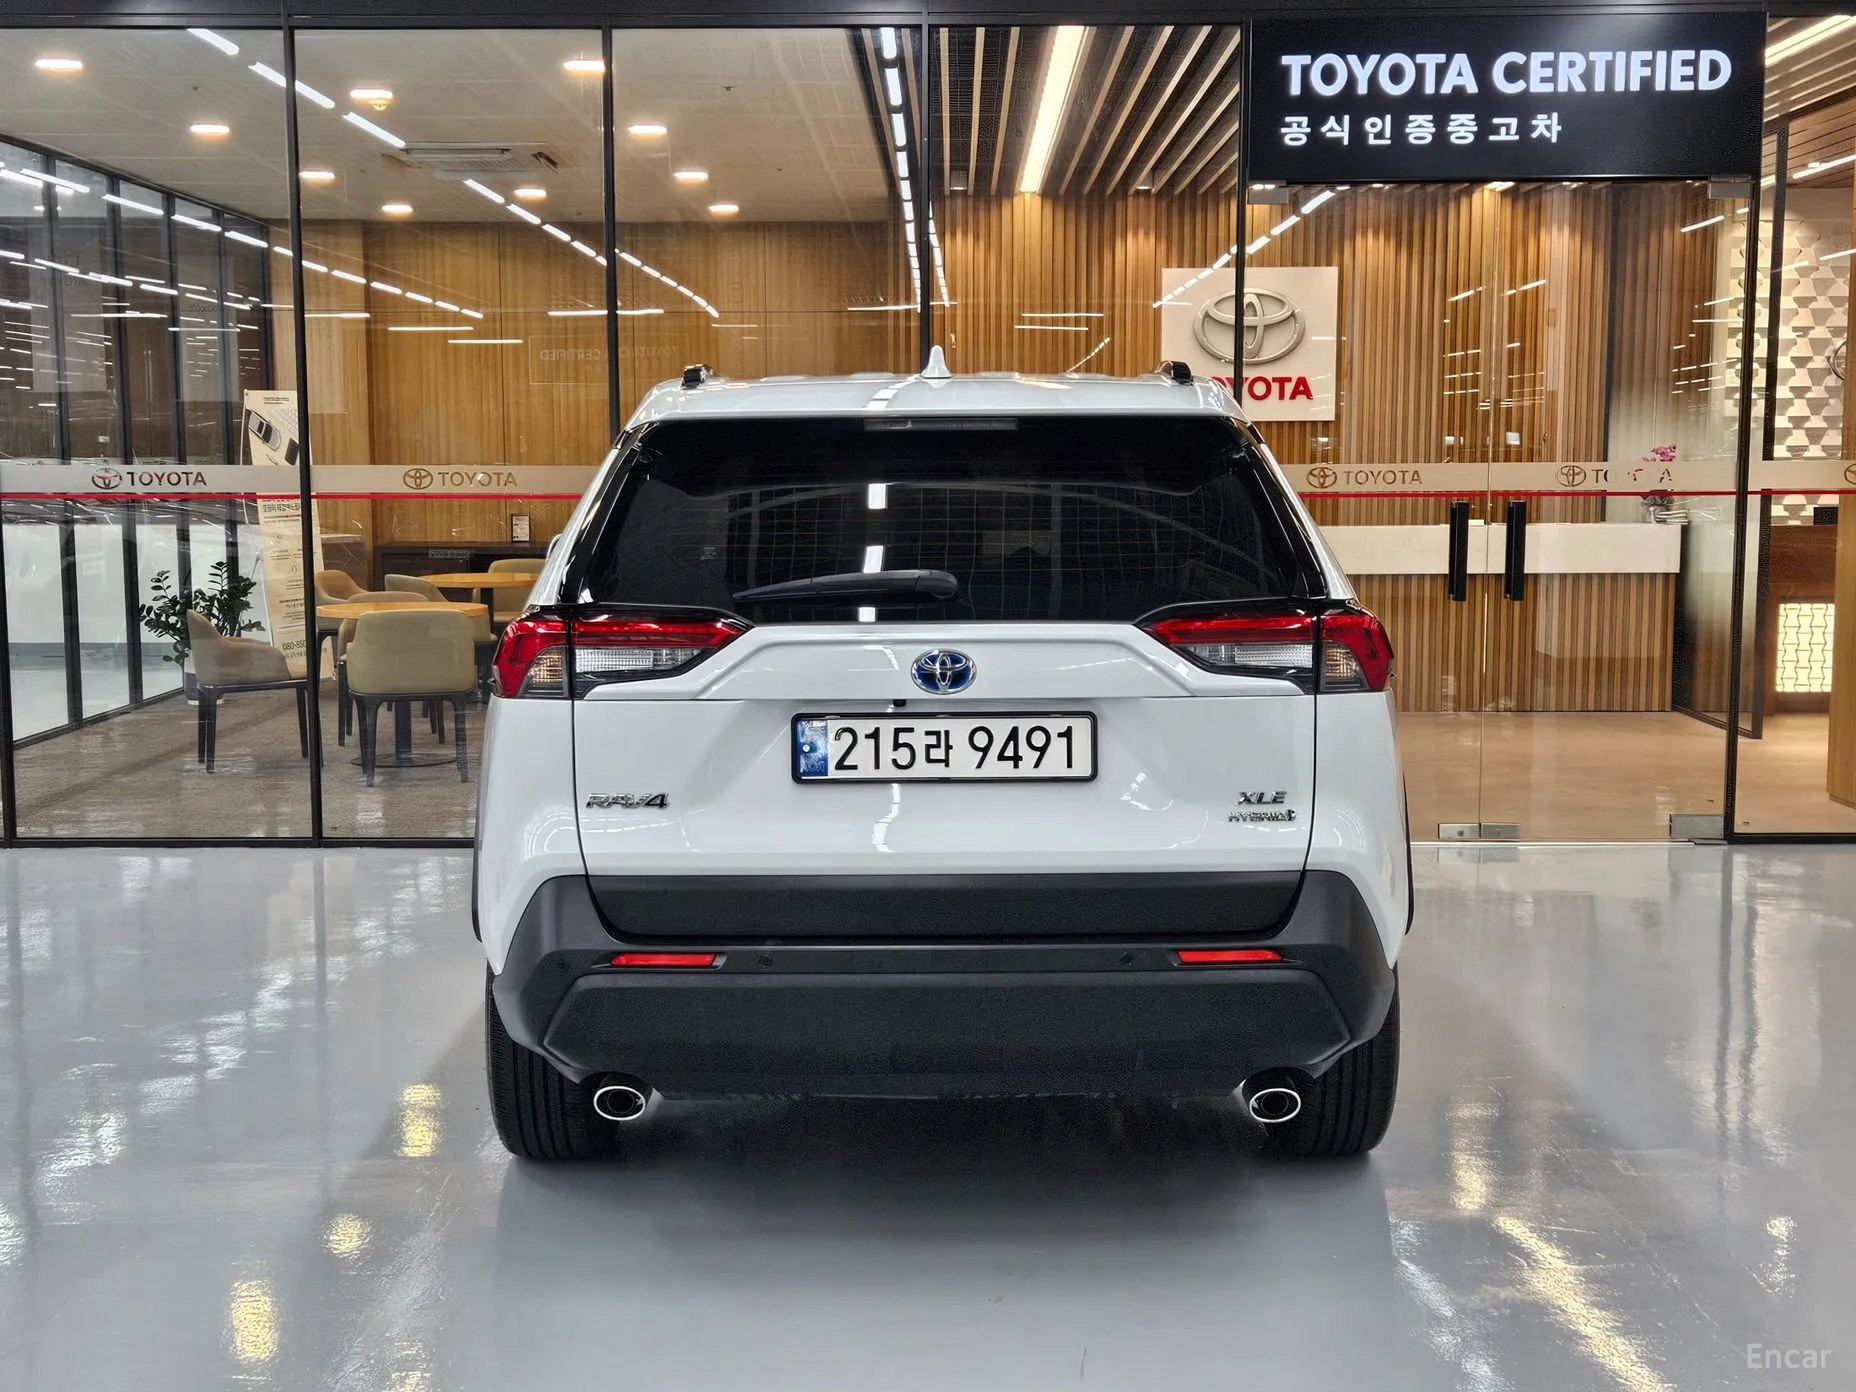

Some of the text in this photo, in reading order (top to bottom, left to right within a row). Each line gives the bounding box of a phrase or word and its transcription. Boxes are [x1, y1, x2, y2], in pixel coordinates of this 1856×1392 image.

[1281, 49, 1732, 96] TOYOTA CERTIFIED
[1281, 111, 1562, 146] 공식인증중고차
[126, 471, 207, 486] TOYOTA
[438, 471, 518, 486] TOYOTA
[1343, 470, 1423, 485] TOYOTA
[834, 725, 1074, 770] 215라 9491
[586, 792, 670, 809] RAV4
[1236, 791, 1287, 805] XLE
